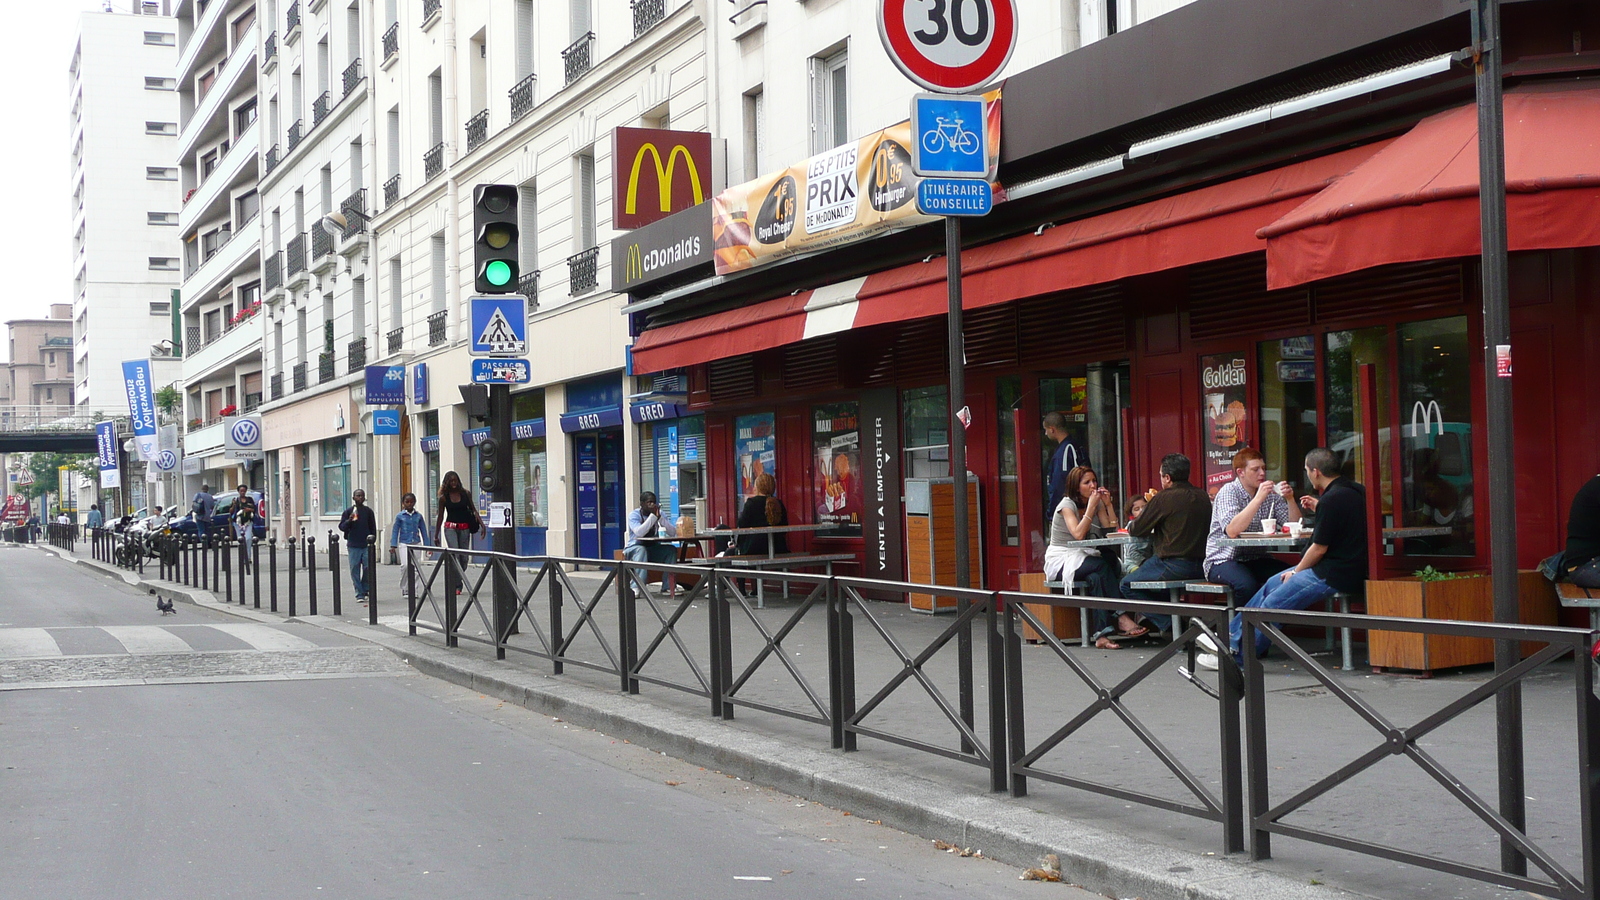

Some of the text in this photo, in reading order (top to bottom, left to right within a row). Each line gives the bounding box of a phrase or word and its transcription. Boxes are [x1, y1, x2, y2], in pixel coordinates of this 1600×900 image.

[914, 0, 988, 46] 30
[808, 147, 856, 180] LES P'TITS
[807, 171, 856, 211] PRIX
[924, 182, 985, 196] ITINÉRAIRE
[925, 196, 985, 210] CONSEILLÉ
[807, 215, 814, 227] DE
[758, 223, 772, 241] Royal
[1203, 363, 1246, 388] Golden
[578, 413, 600, 429] BRED
[640, 403, 665, 421] BRED
[515, 424, 533, 439] BRED
[875, 417, 886, 571] VENTE A EMPORTER
